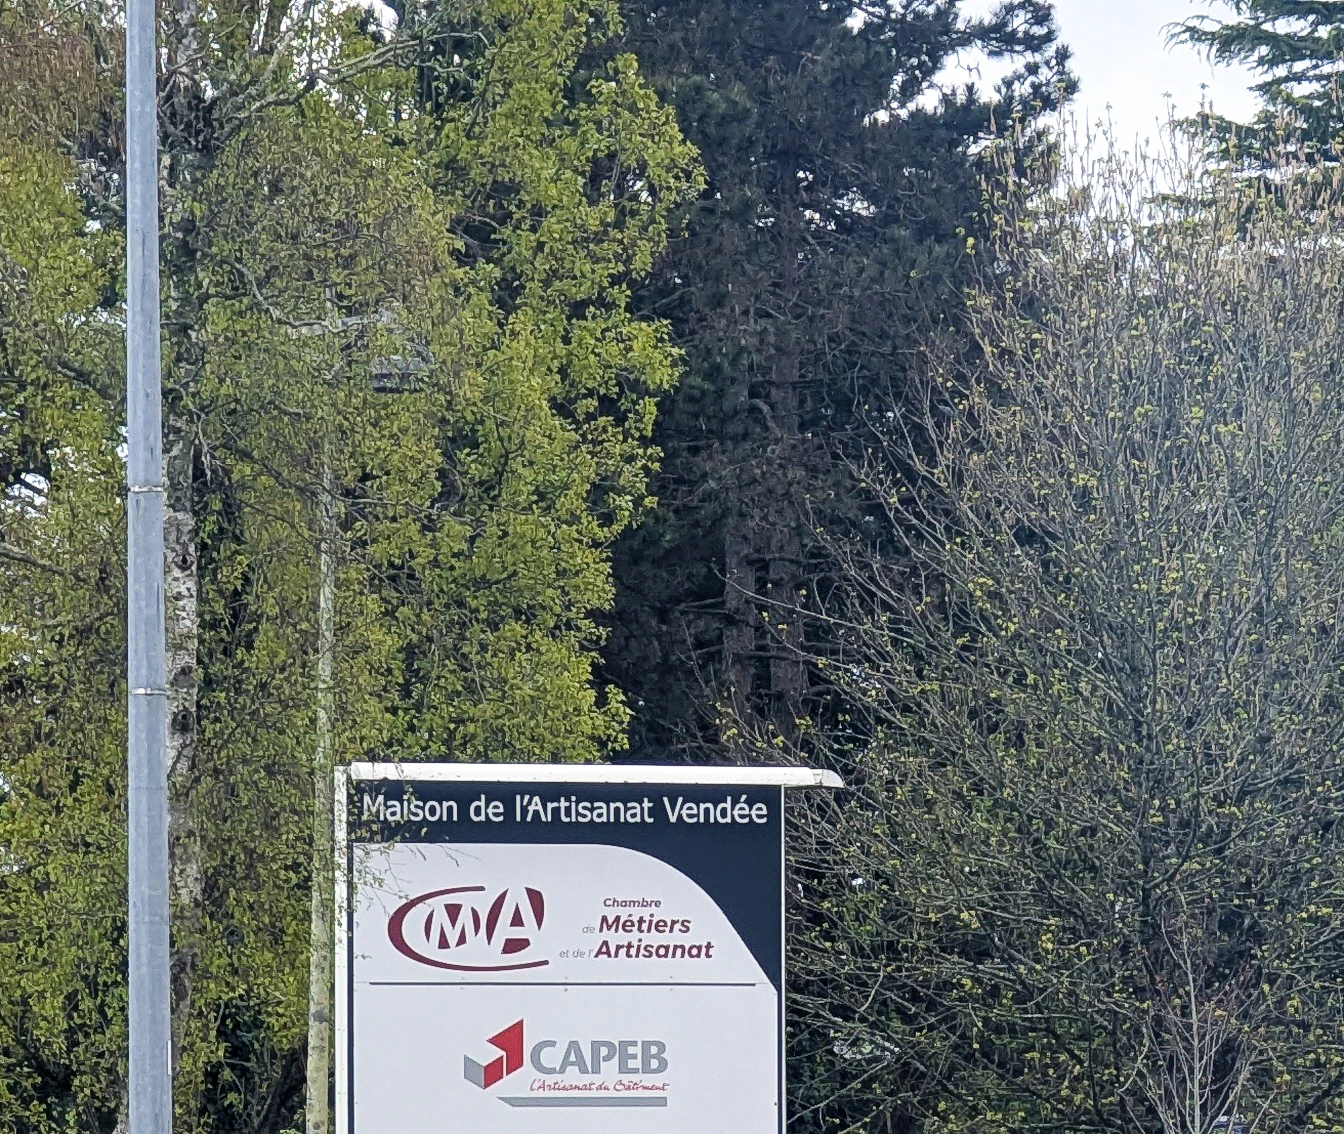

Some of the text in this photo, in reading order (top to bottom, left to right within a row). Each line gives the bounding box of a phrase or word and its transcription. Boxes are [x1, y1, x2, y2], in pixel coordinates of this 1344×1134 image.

[363, 793, 768, 824] Maison de l'Artisanat Vendée
[603, 897, 662, 908] Chambre
[387, 885, 550, 972] CMA
[598, 913, 692, 934] Métiers
[559, 949, 569, 958] et
[572, 949, 585, 958] de
[530, 1039, 669, 1075] CAPEB
[596, 1080, 610, 1092] du
[614, 1079, 670, 1092] Bâtiment
